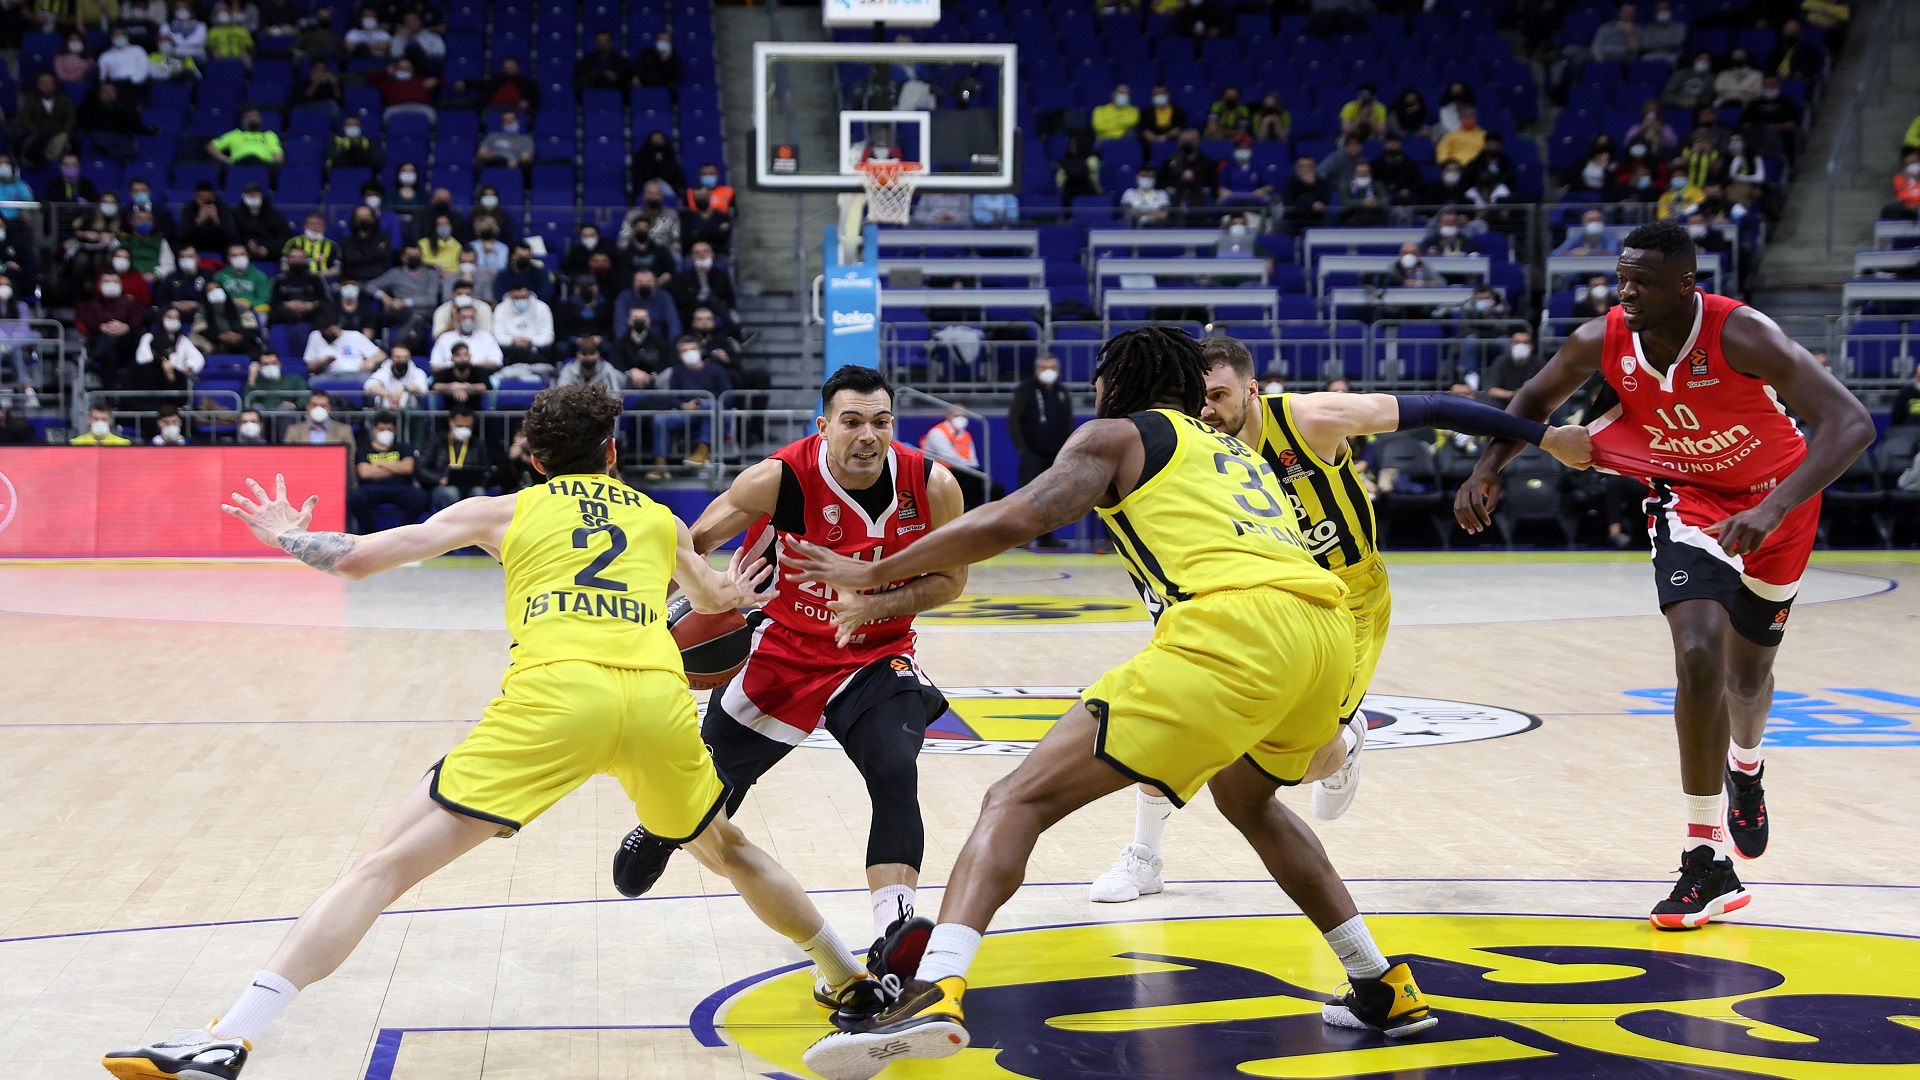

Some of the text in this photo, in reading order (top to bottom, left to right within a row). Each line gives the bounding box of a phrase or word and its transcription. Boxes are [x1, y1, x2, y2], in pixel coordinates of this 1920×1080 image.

[832, 310, 876, 326] beko
[1656, 403, 1700, 431] 10
[548, 480, 643, 507] HAZER
[571, 523, 628, 592] 2
